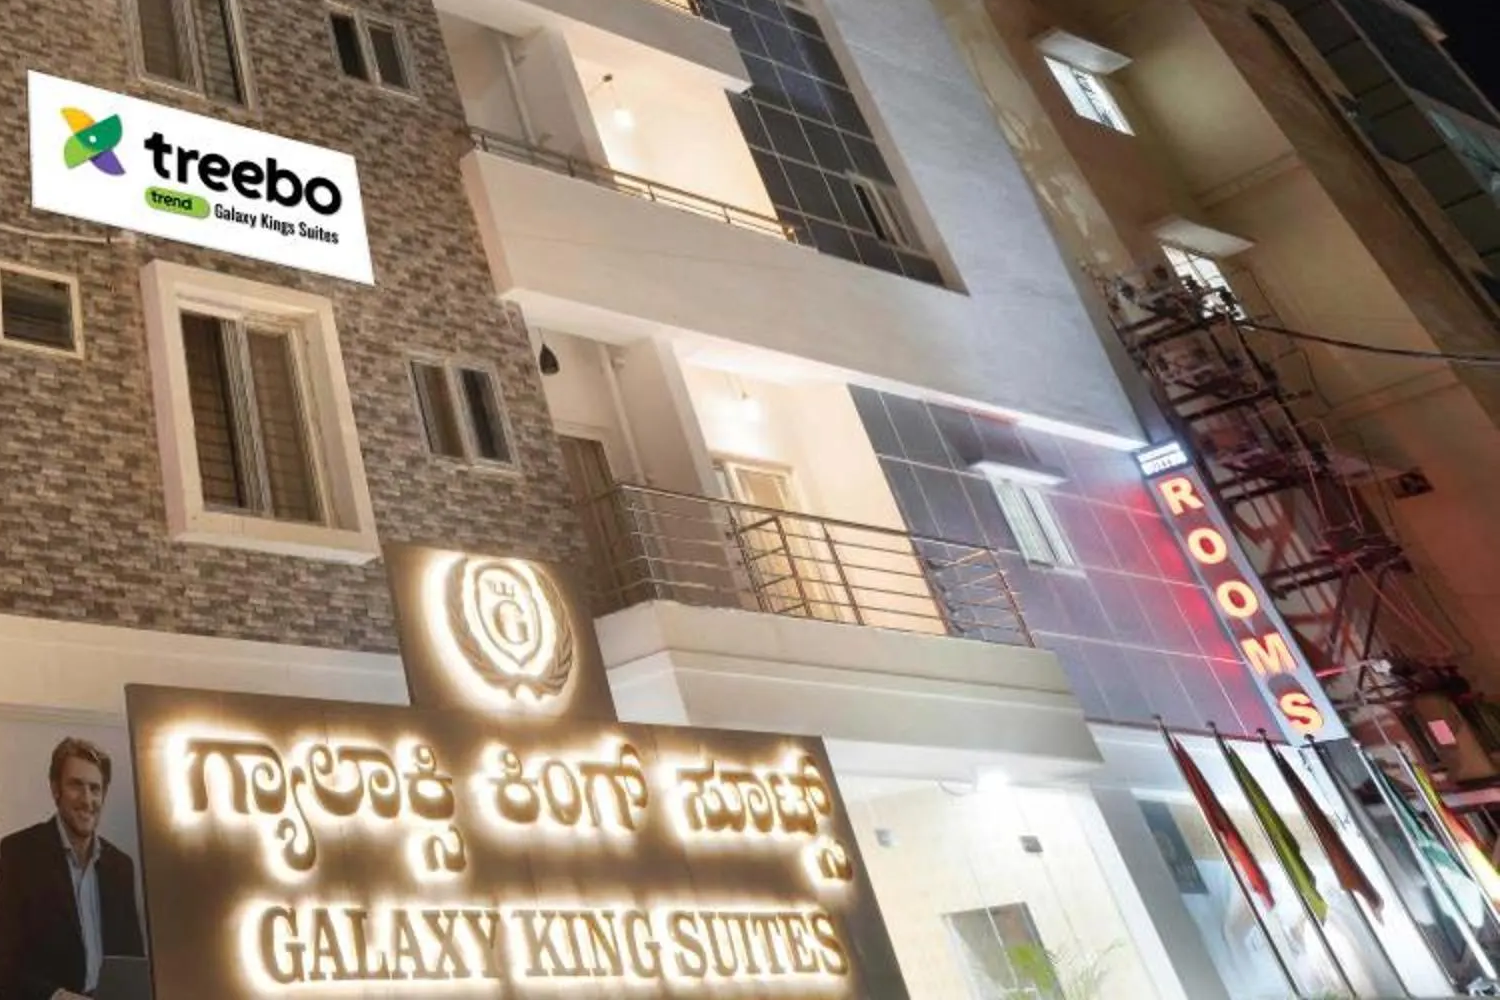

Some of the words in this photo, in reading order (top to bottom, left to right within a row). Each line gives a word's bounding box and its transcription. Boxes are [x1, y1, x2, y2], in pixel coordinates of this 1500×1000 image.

[144, 132, 342, 215] treebo
[151, 190, 192, 211] trend
[214, 203, 257, 229] Galaxy
[261, 213, 295, 236] Kings
[299, 222, 339, 244] Suites
[1158, 475, 1326, 733] ROOMS
[487, 744, 648, 831] ಕಿಂಗ್
[259, 906, 501, 985] GALAXY
[511, 908, 663, 981] KING
[667, 907, 850, 978] SUITES
